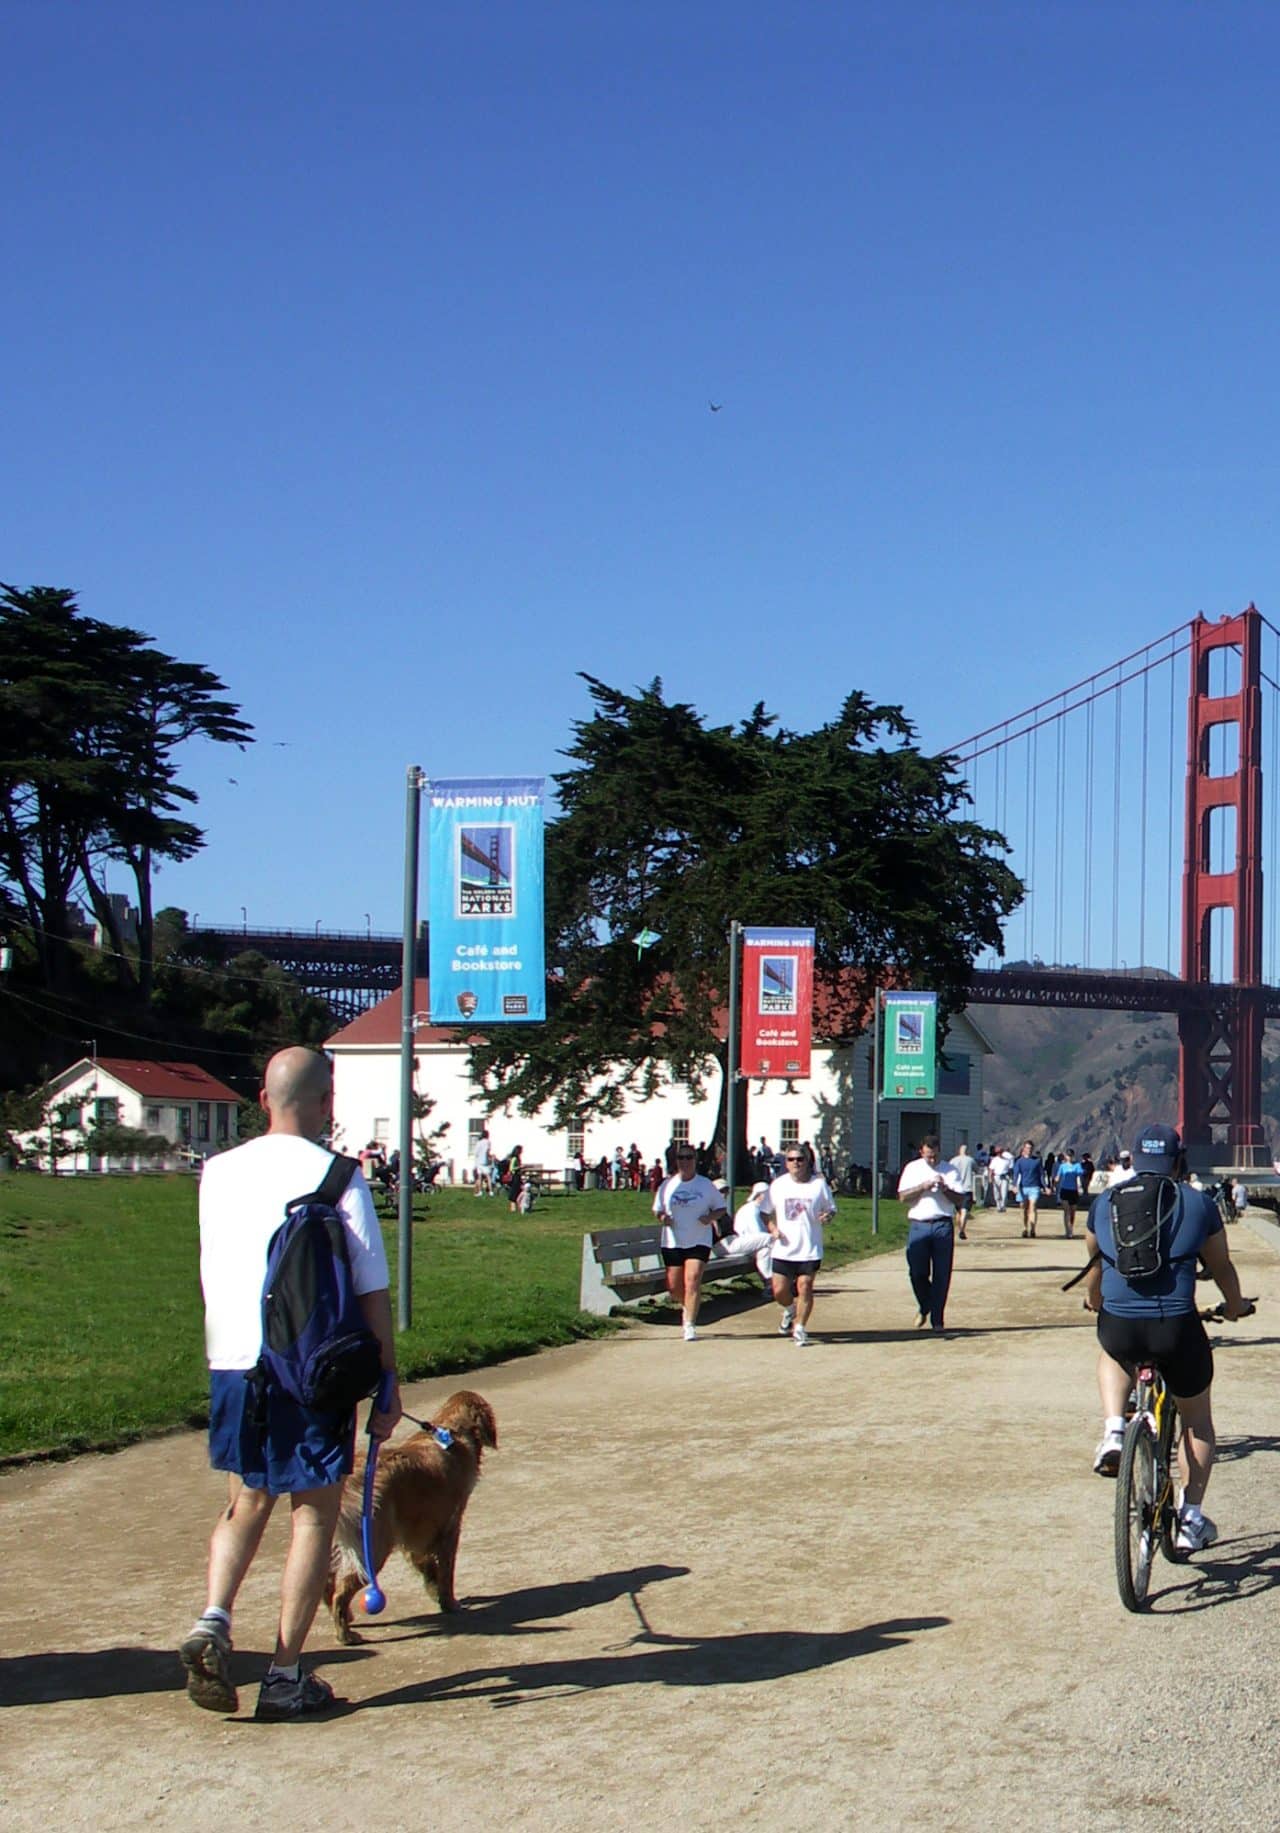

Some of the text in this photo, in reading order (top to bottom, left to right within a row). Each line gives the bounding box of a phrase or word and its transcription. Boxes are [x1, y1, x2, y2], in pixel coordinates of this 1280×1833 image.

[431, 795, 538, 808] WARMING HUT
[461, 902, 512, 913] PARKS
[746, 938, 811, 947] WARMING HUT
[456, 944, 518, 957] Café and
[451, 959, 522, 972] Bookstore
[780, 1029, 797, 1037] and
[755, 1038, 799, 1046] Bookstore
